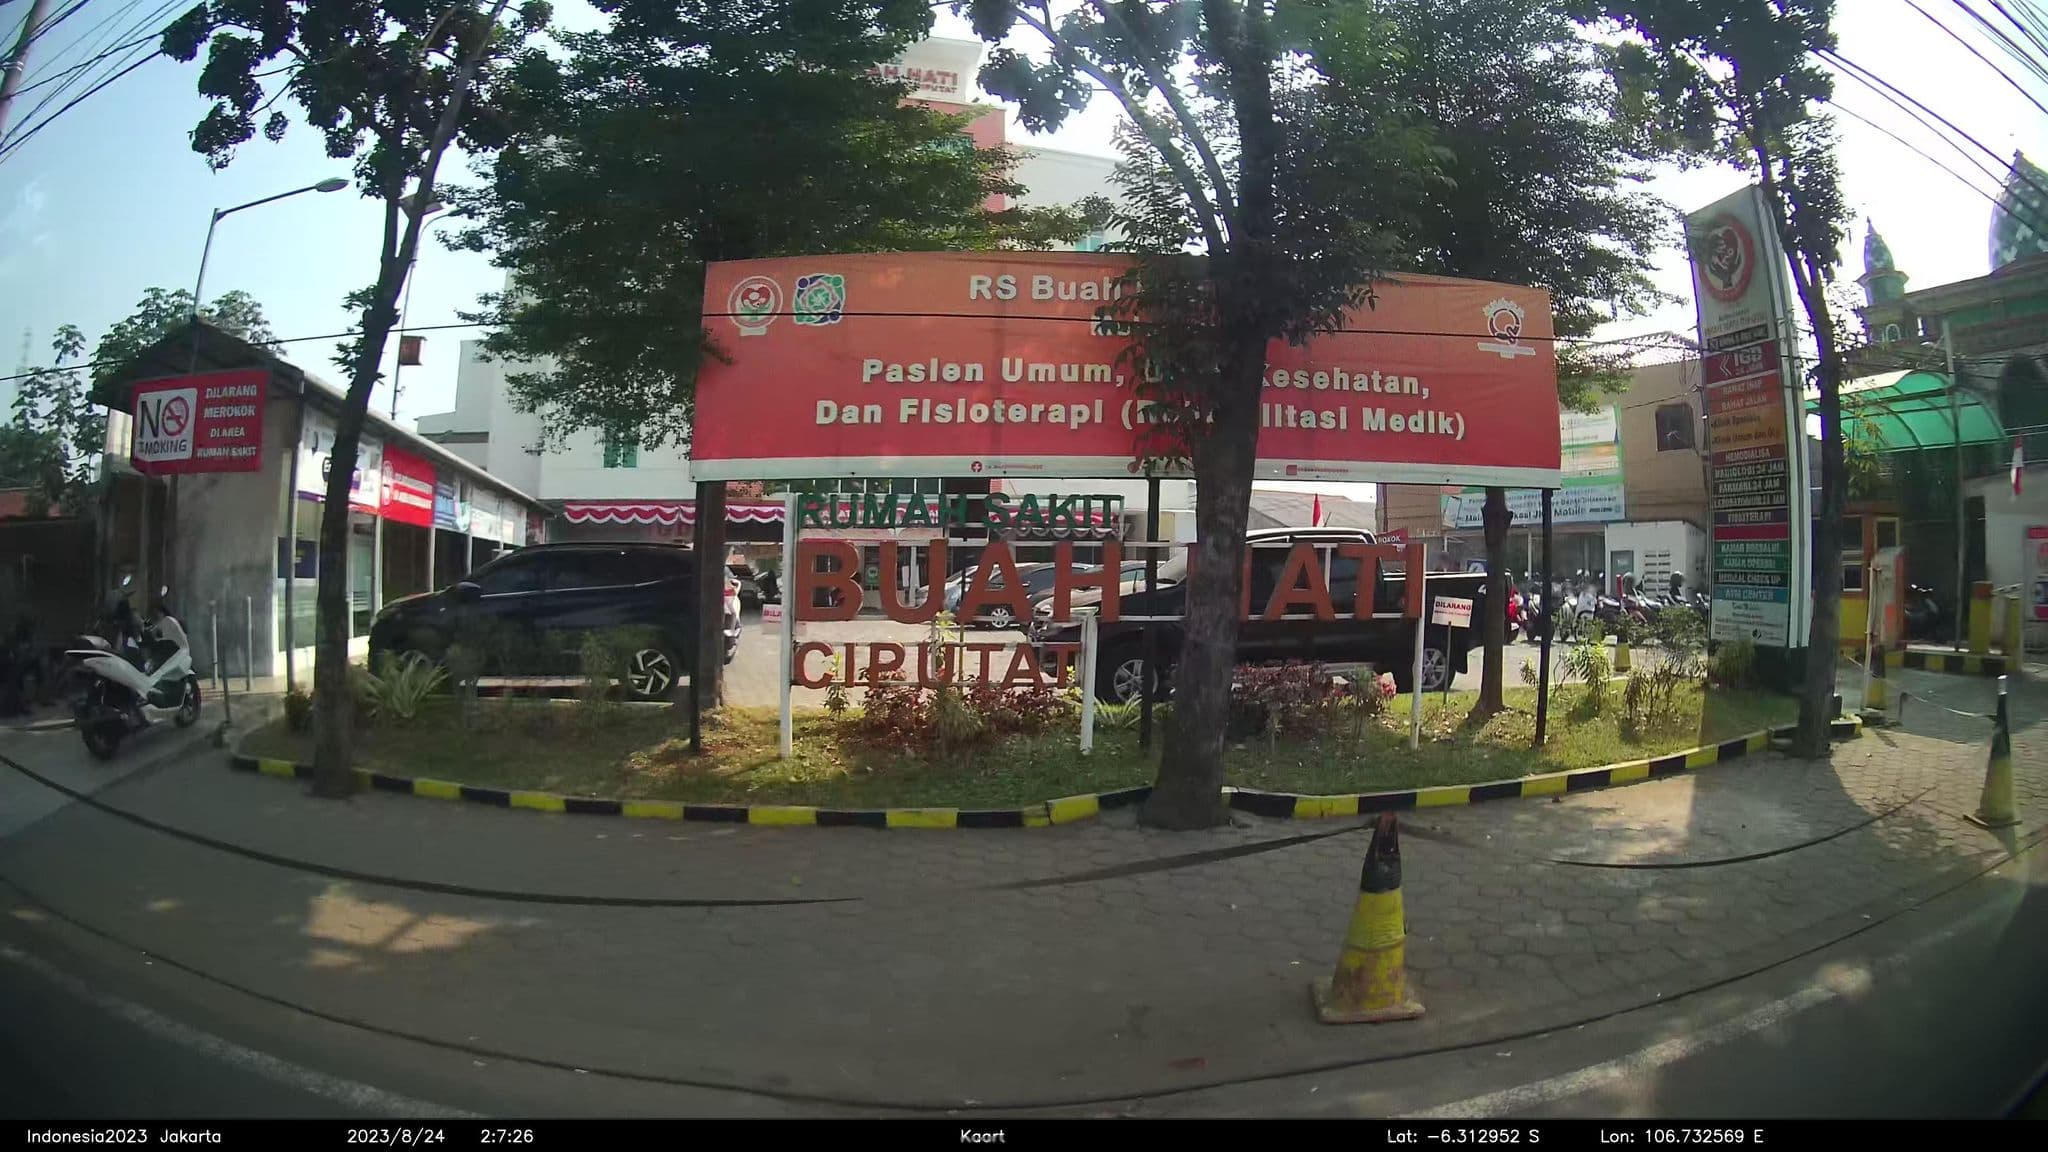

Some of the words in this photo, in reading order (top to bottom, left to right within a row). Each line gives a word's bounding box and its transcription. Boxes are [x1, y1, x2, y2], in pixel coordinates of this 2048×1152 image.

[969, 275, 1017, 300] RS
[862, 357, 984, 382] Pasien
[1002, 357, 1125, 387] Umum,
[205, 384, 257, 399] DILARANG
[203, 405, 256, 418] MEROKOK
[816, 399, 882, 425] Dan
[900, 397, 1103, 430] Fisioterapi
[1362, 407, 1466, 441] Medik)
[798, 493, 967, 530] RUMAH
[983, 493, 1123, 530] SAKIT
[796, 537, 1122, 624] BUAH
[1435, 601, 1472, 611] DILARANG
[793, 640, 1083, 692] CIPUTAT
